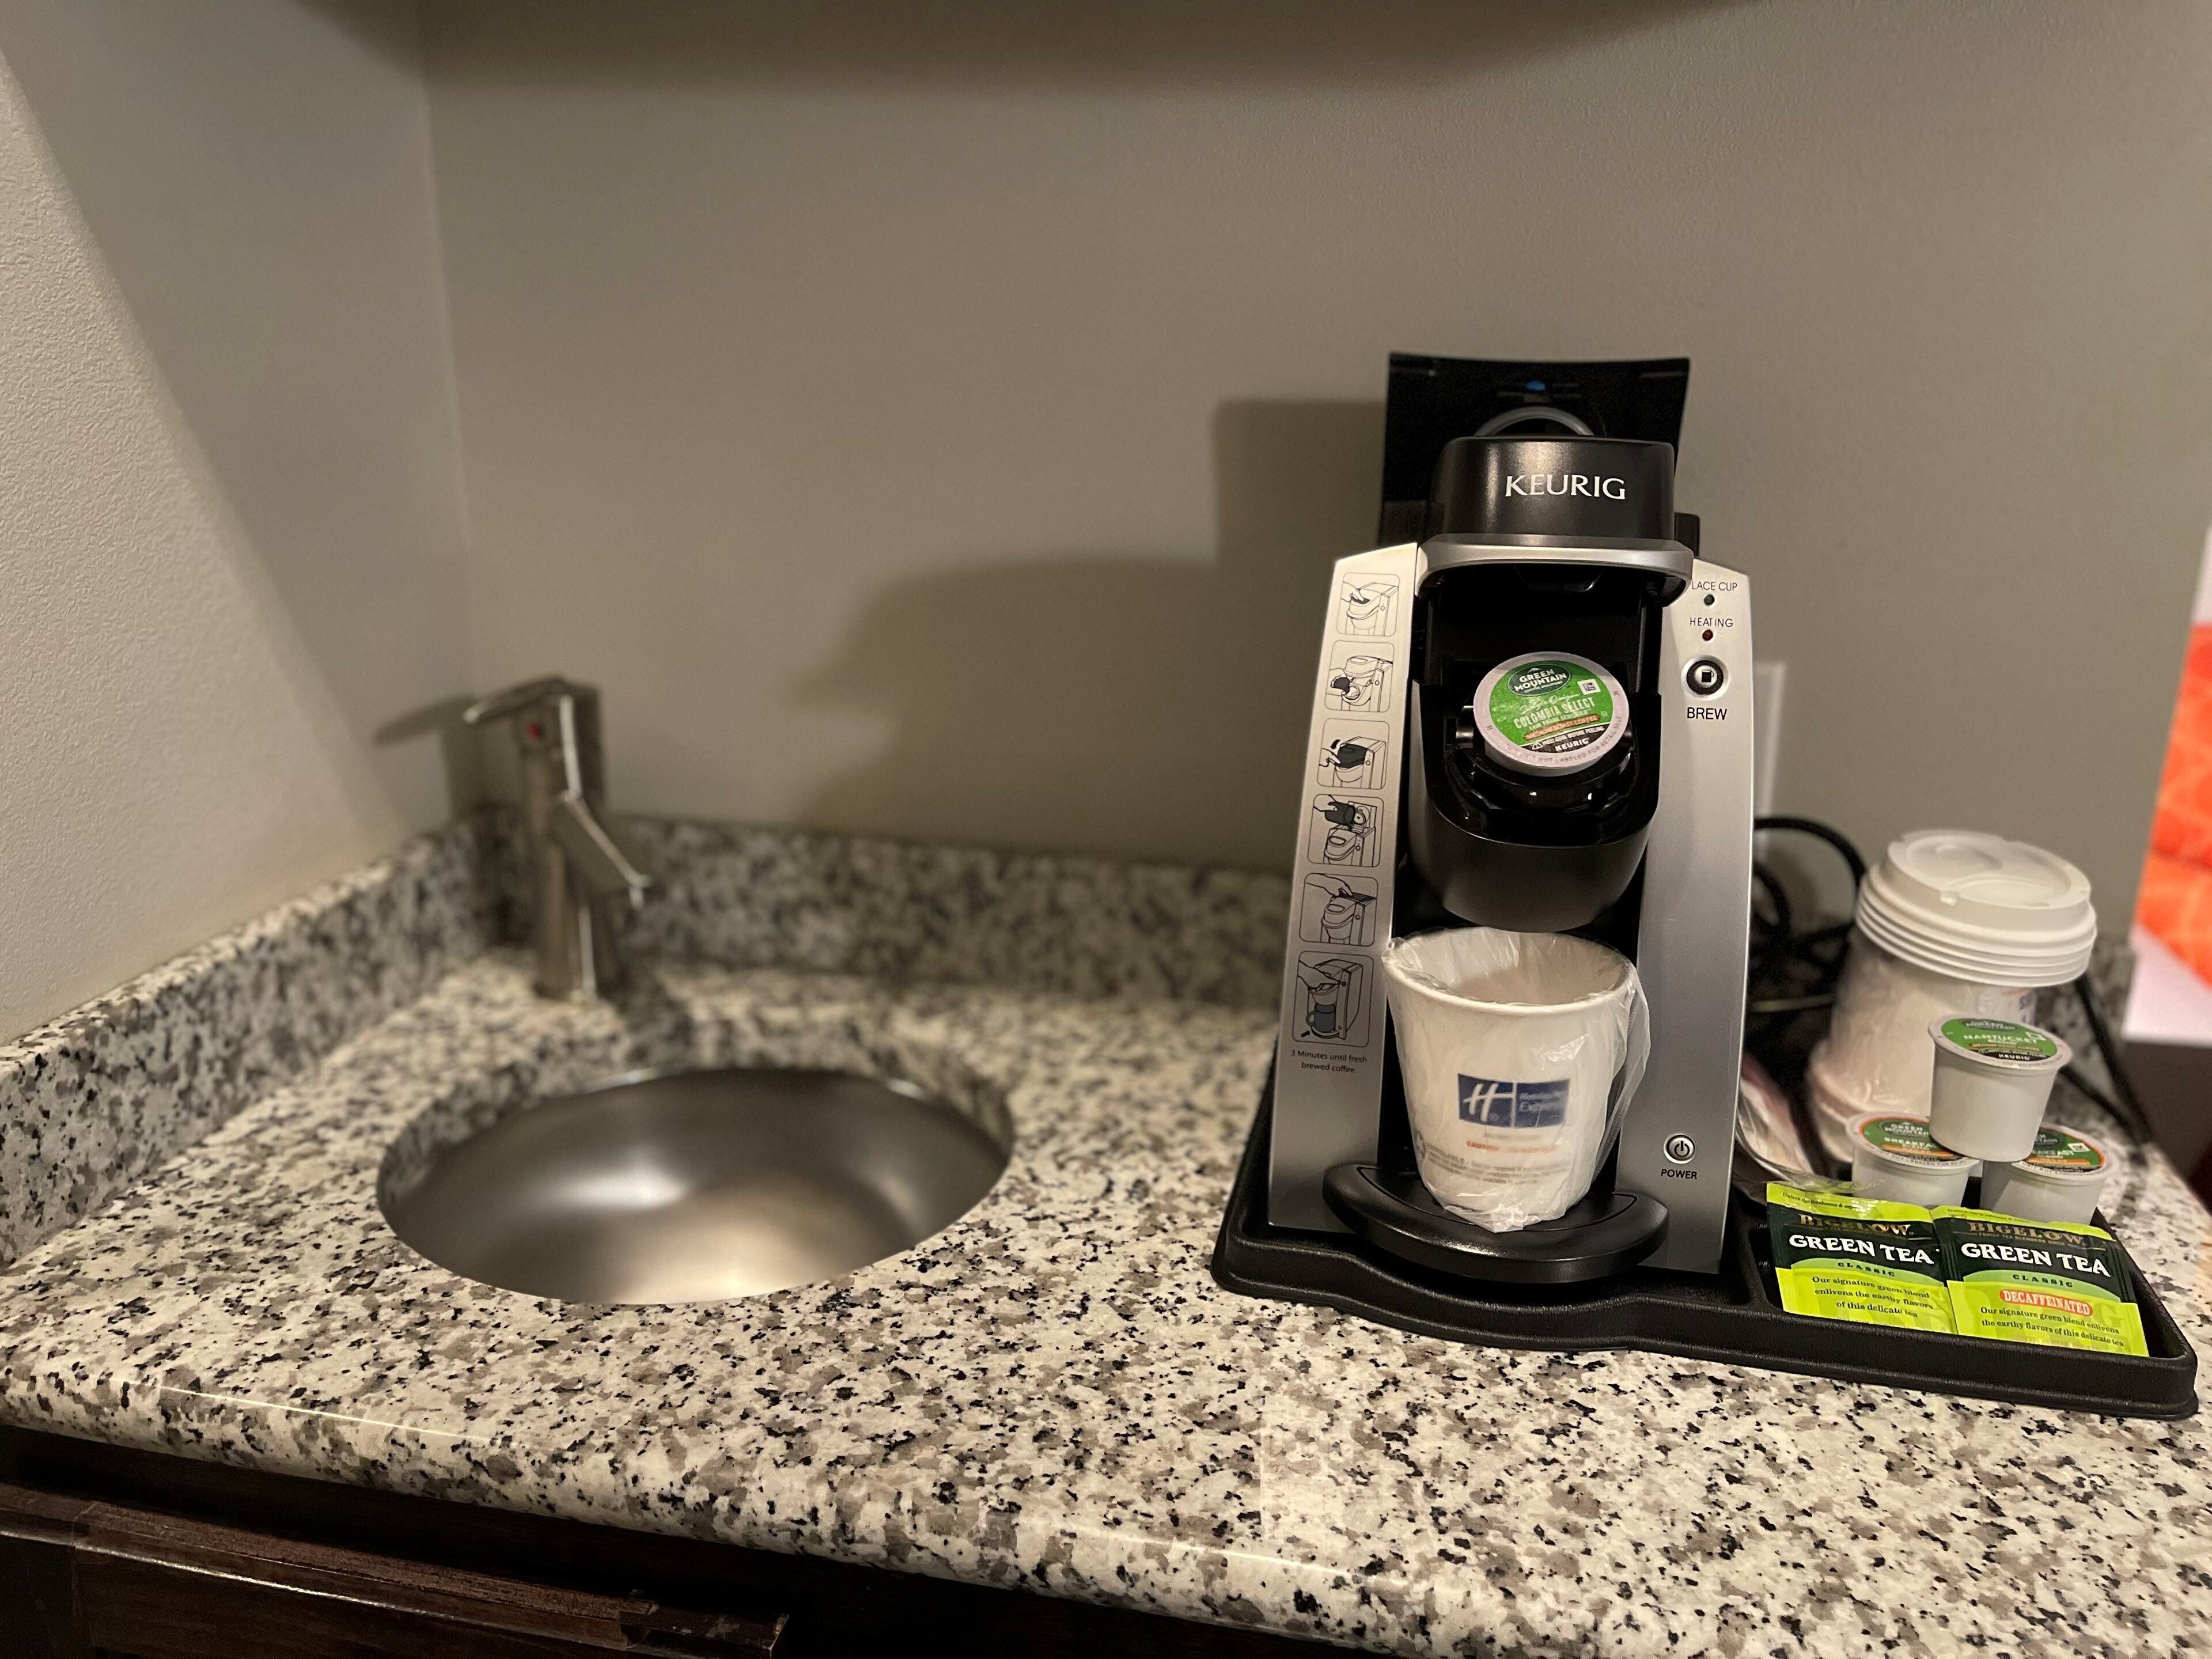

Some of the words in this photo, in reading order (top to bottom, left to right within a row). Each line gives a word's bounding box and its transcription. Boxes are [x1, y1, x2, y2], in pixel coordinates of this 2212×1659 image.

[1505, 474, 1626, 500] KEURIG
[1691, 581, 1715, 590] LACE
[1718, 582, 1737, 591] CUP
[1690, 617, 1733, 627] HEATING
[1514, 673, 1567, 691] MOUNTAIN
[1519, 669, 1555, 683] GREEN
[1513, 704, 1562, 729] COLOMBIA
[1561, 697, 1595, 714] SELECT
[1687, 707, 1728, 720] BREW
[1555, 738, 1590, 752] KEURIG
[1963, 1035, 2037, 1044] NANTUCKET
[1297, 1050, 1328, 1059] Minutes
[1330, 1053, 1347, 1062] until
[1349, 1054, 1368, 1063] fresh
[1301, 1062, 1330, 1070] brewed
[1332, 1065, 1355, 1073] coffee
[1885, 1126, 1929, 1137] MOUNTAI
[1661, 1169, 1698, 1180] POWER
[1967, 1221, 2084, 1245] BIGELOW
[1789, 1234, 1876, 1257] GREEN
[1880, 1244, 1935, 1264] TEA
[1961, 1243, 2052, 1266] GREEN
[2056, 1252, 2111, 1278] TEA
[1838, 1262, 1895, 1277] CLASSIC
[1832, 1278, 1876, 1289] signature
[1877, 1285, 1902, 1294] green
[1904, 1288, 1930, 1298] blend
[2013, 1274, 2073, 1287] CLASSIC
[1815, 1288, 1853, 1297] enlivens
[1855, 1290, 1870, 1298] the
[1872, 1293, 1900, 1304] earthy
[1903, 1298, 1934, 1309] flavors
[2003, 1289, 2091, 1316] DECAFFEINATED
[1847, 1301, 1865, 1310] this
[1867, 1303, 1902, 1314] delicate
[1904, 1310, 1918, 1318] tea
[1980, 1306, 1997, 1315] Our
[1999, 1307, 2038, 1319] signature
[2039, 1313, 2062, 1323] green
[2063, 1316, 2085, 1327] blend
[2086, 1322, 2119, 1334] enlivens
[1997, 1320, 2024, 1331] earthy
[2025, 1321, 2053, 1334] flavors
[2063, 1328, 2080, 1338] this
[2081, 1331, 2111, 1343] delicate
